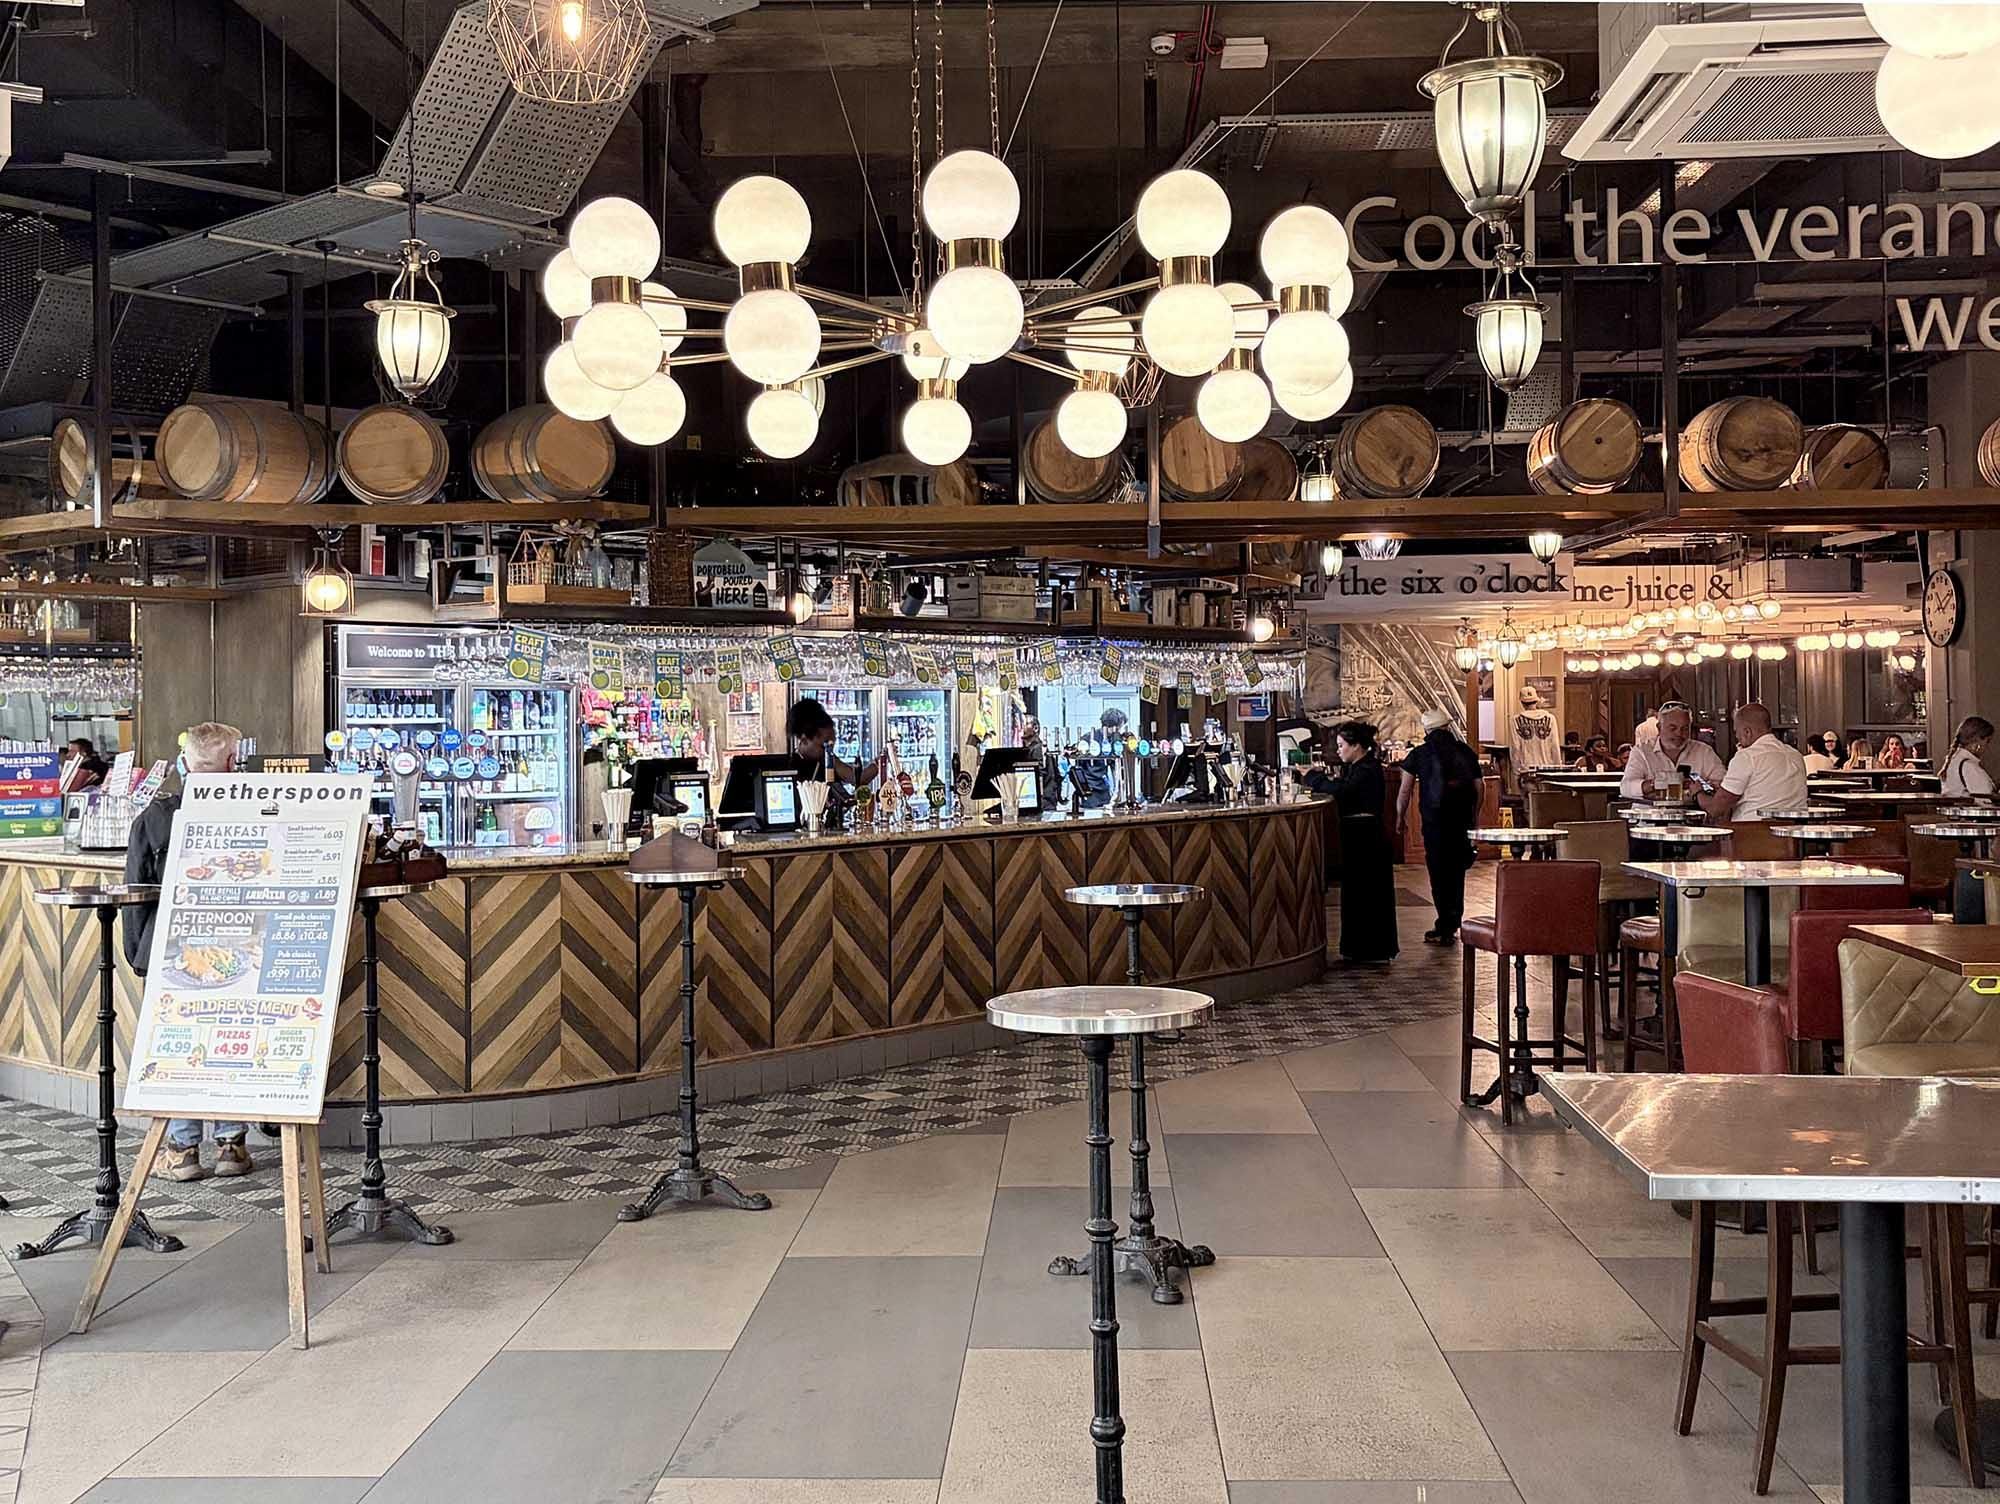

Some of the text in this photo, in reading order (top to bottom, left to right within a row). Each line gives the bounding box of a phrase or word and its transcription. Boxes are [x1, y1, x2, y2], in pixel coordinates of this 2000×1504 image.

[1564, 188, 1711, 265] the
[1737, 201, 2000, 262] veran
[696, 564, 746, 576] PORTOBELLO
[723, 575, 753, 586] POURED
[1339, 566, 1387, 596] the
[1401, 568, 1444, 595] six
[1459, 563, 1569, 594] o'clock
[1707, 575, 1733, 600] &
[715, 587, 749, 605] HERE
[515, 635, 545, 648] CRAFT
[770, 640, 793, 650] CRAFT
[368, 645, 413, 658] Welcome
[414, 647, 426, 658] to
[514, 643, 543, 657] CIDER
[774, 647, 796, 659] CIDER
[656, 657, 680, 666] CRAFT
[717, 653, 740, 663] CRAFT
[530, 666, 540, 677] 15
[656, 665, 680, 674] CIDER
[16, 768, 32, 780] £6
[193, 783, 363, 803] wetherspoon
[930, 788, 945, 803] IPA
[187, 826, 268, 837] BREAKFAST
[185, 839, 231, 849] DEALS
[322, 852, 341, 861] £5.91
[200, 887, 240, 895] FREE REFILLS
[173, 912, 255, 924] AFTERNOON
[274, 912, 331, 922] Small pub classics
[170, 925, 214, 936] DEALS
[278, 950, 316, 958] Pub classics
[266, 969, 290, 978] £9.99
[177, 998, 299, 1018] CHILDREN'S MENU
[216, 1030, 251, 1040] PIZZAS
[156, 1041, 192, 1054] £4.99
[214, 1043, 249, 1055] £4.99
[273, 1044, 304, 1056] £5.75
[259, 1093, 309, 1101] wetherspoon
